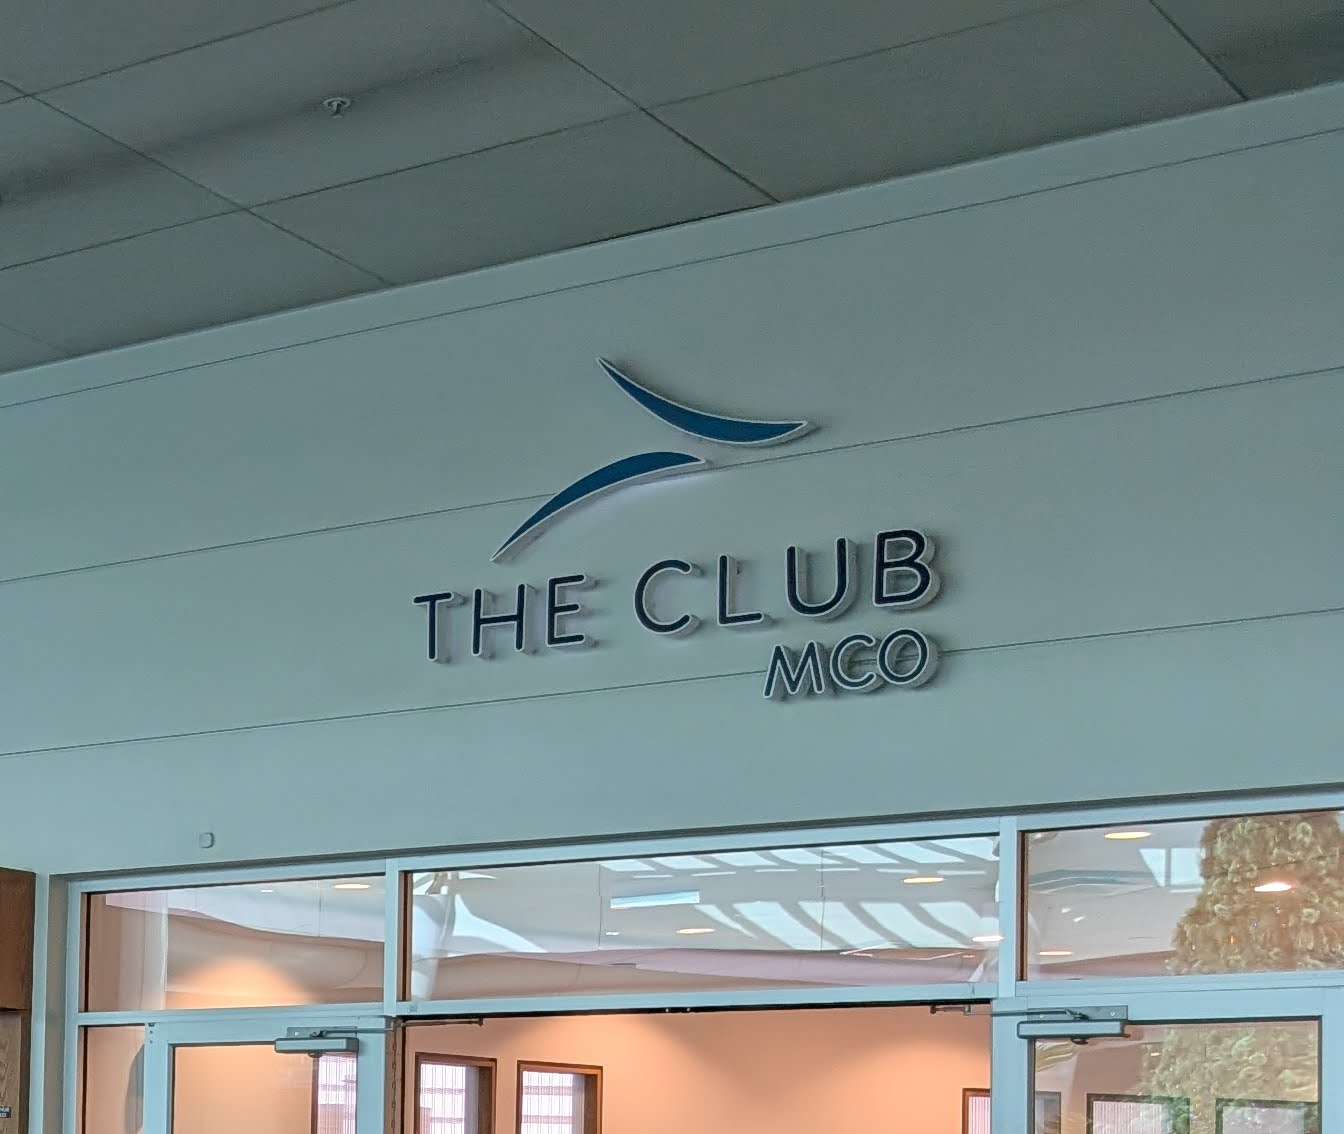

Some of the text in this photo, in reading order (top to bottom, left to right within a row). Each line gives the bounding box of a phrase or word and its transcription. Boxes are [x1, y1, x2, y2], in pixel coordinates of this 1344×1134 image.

[413, 529, 935, 662] THE CLUB
[763, 627, 931, 699] MCO
